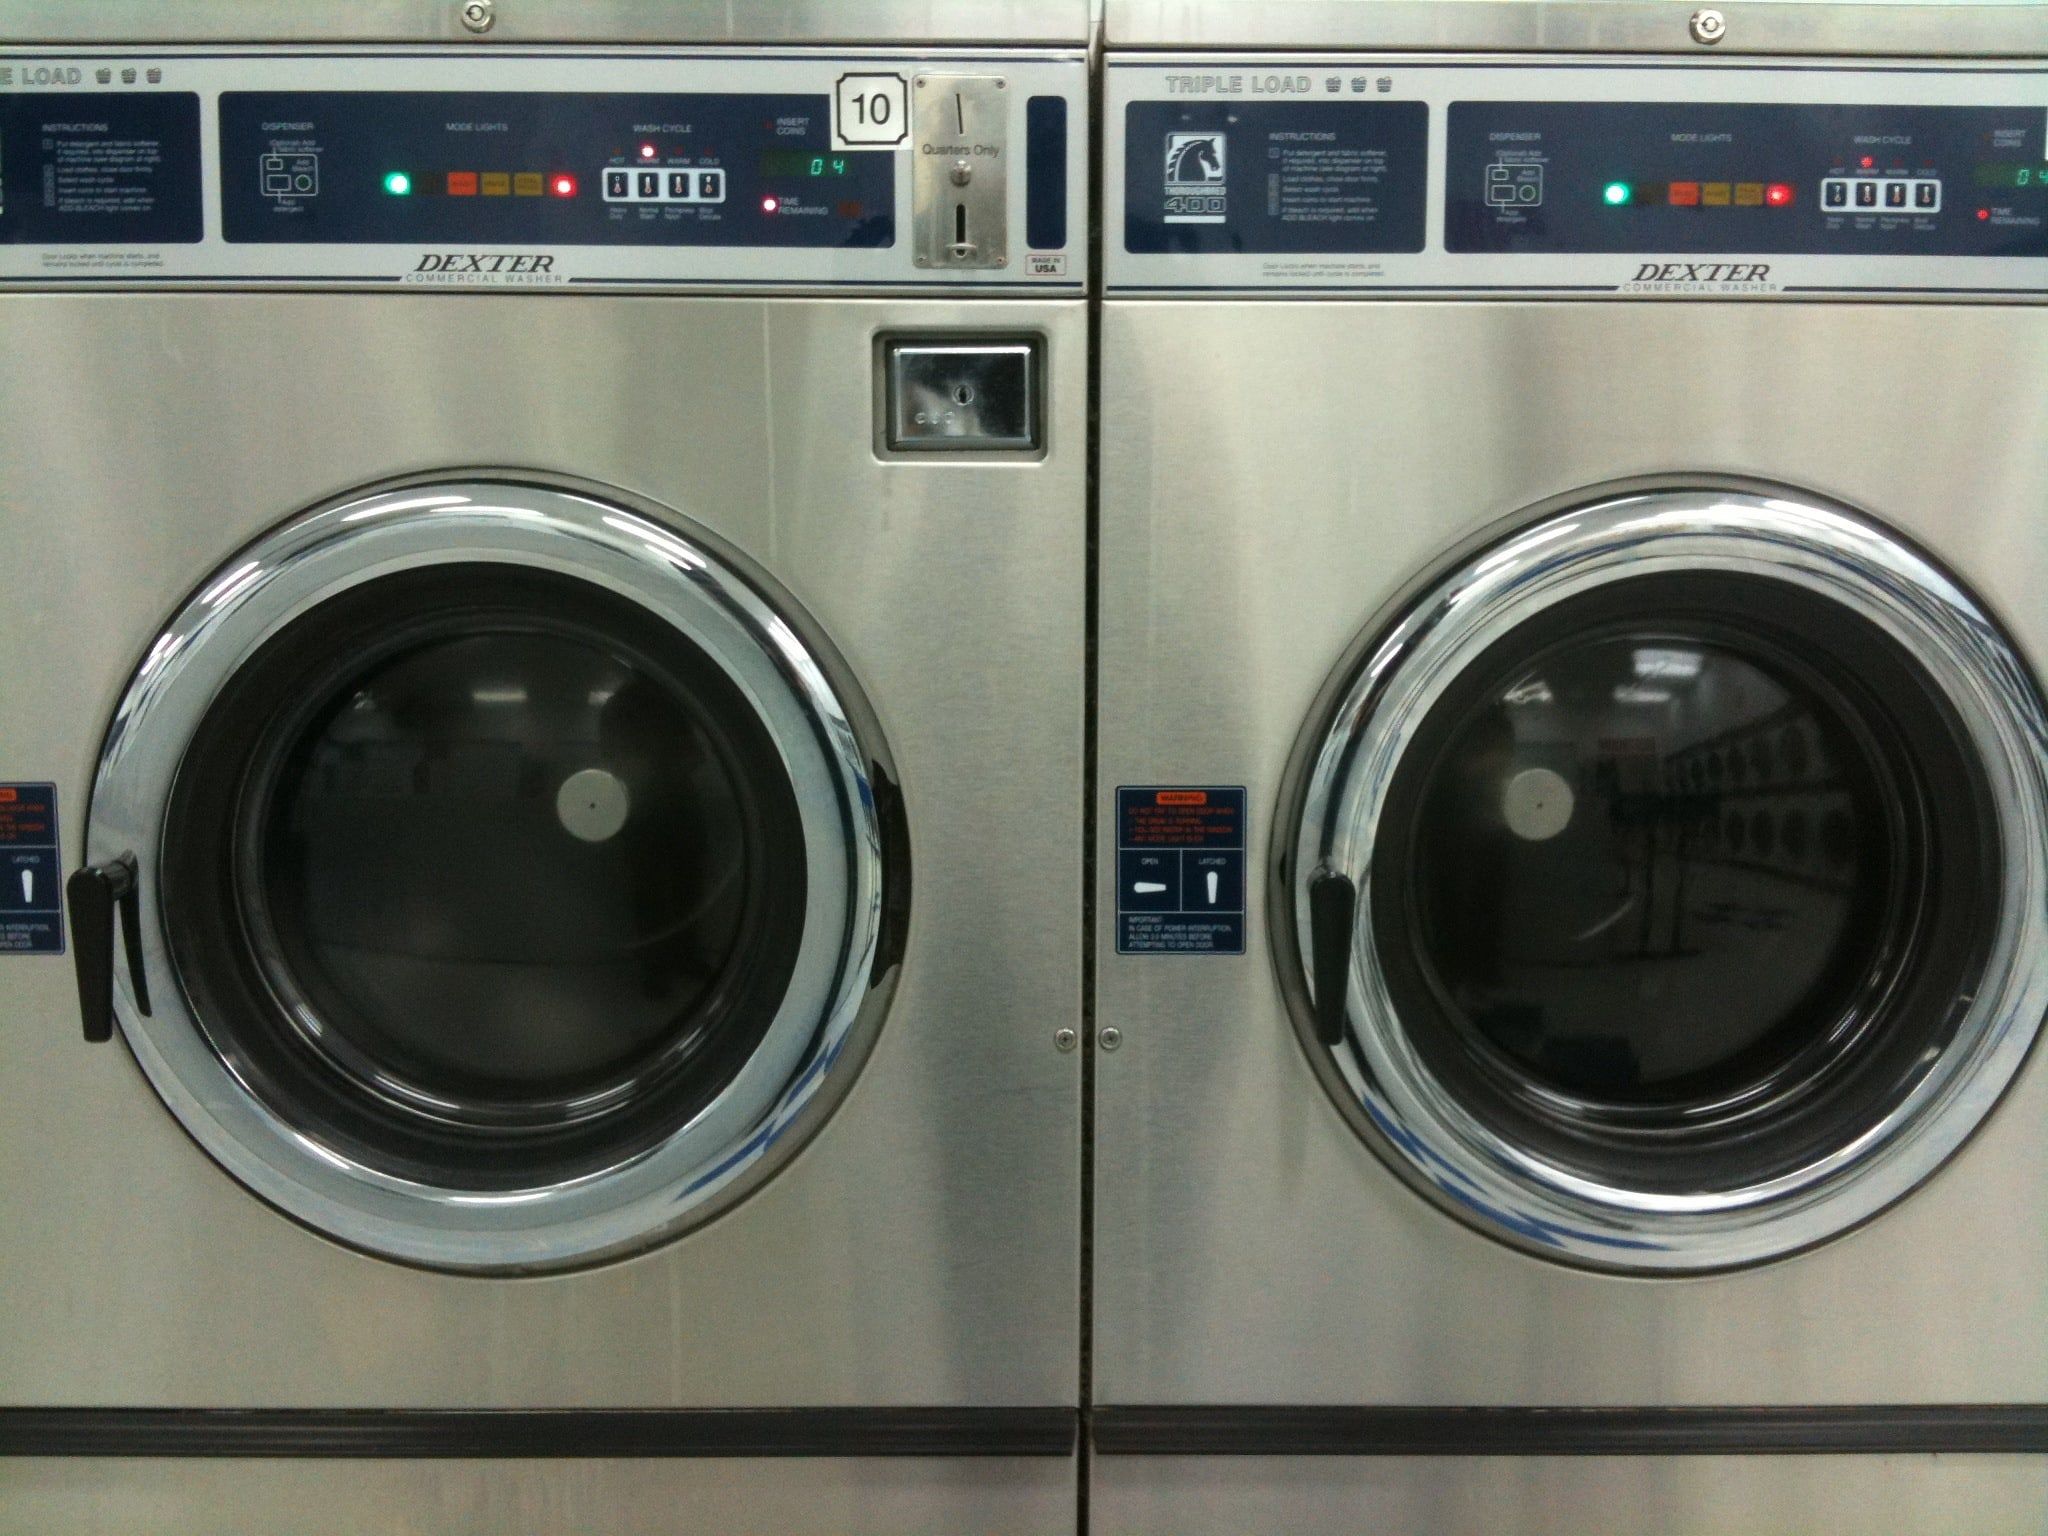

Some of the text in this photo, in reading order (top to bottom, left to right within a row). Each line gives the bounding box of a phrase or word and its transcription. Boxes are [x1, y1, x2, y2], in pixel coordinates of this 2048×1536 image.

[22, 67, 82, 85] LOAD
[1165, 76, 1311, 93] TRIPLE LOAD
[851, 92, 890, 125] 10
[776, 117, 809, 126] INSERT
[42, 123, 108, 132] INSTRUCTIONS
[261, 122, 314, 131] DISPENSER
[446, 123, 508, 131] MODE LIGHTS
[633, 124, 692, 133] WASH CYCLE
[776, 127, 806, 135] COINS
[1269, 132, 1336, 141] INSTRUCTIONS
[1490, 132, 1541, 141] DISPENSER
[1671, 133, 1732, 142] MODE LIGHTS
[1994, 130, 2026, 138] INSERT
[1854, 136, 1912, 145] WASH CYCLE
[922, 143, 1000, 158] Quarters Only
[778, 197, 799, 205] TIME
[1164, 197, 1226, 213] 400
[778, 207, 828, 215] REMAINING
[414, 254, 554, 273] DEXTER
[1035, 264, 1056, 273] USA
[1632, 264, 1770, 281] DEXTER
[406, 274, 562, 283] COMMERCIAL WASHER
[1623, 283, 1777, 292] COMMERCIAL WASHER
[1141, 857, 1159, 865] OPEN
[1198, 857, 1227, 865] LATCHED
